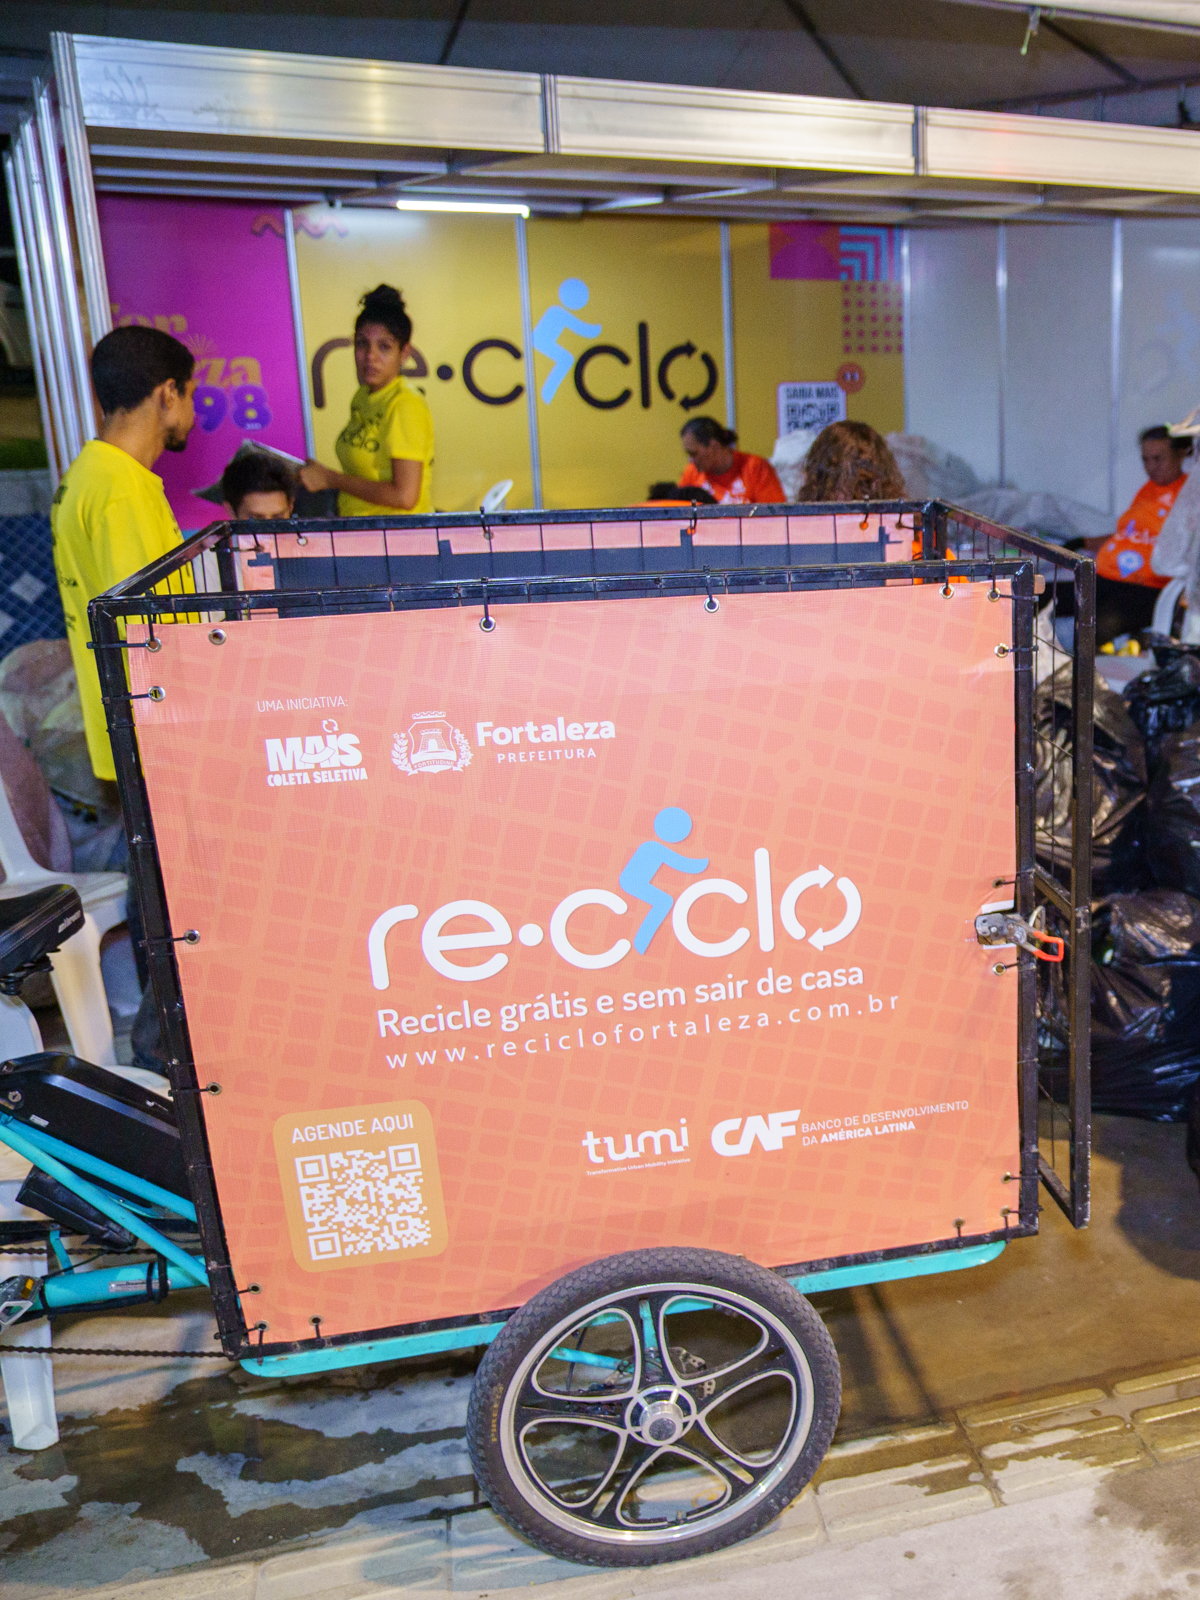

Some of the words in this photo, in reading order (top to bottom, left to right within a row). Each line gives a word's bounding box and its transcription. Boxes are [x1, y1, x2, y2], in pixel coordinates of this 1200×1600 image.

[257, 698, 285, 713] UMA
[286, 694, 349, 711] INICIATIVA:
[476, 716, 617, 747] Fortaleza
[265, 732, 364, 772] MAIS
[413, 759, 455, 770] FORTITUDINE
[496, 747, 597, 764] PREFEITURA
[267, 771, 311, 788] COLETA
[313, 767, 369, 784] SELETIVA
[378, 998, 492, 1038] Recicle
[499, 993, 589, 1032] grátis
[596, 994, 615, 1014] e
[621, 985, 687, 1012] sem
[694, 973, 749, 1004] sair
[756, 968, 793, 996] de
[799, 966, 864, 990] casa
[385, 993, 900, 1070] www.reciclofortaleza.com.br
[291, 1118, 367, 1144] AGENDE
[370, 1112, 415, 1134] AQUI
[801, 1117, 843, 1133] BANCO
[844, 1114, 861, 1129] DE
[861, 1100, 970, 1126] DESENVOLVIMENTO
[581, 1117, 690, 1164] tumi
[711, 1109, 801, 1157] CAF
[802, 1135, 819, 1147] DA
[819, 1124, 874, 1145] AMÉRICA
[873, 1120, 917, 1138] LATINA
[586, 1166, 627, 1177] Transformative
[627, 1164, 645, 1172] Urban
[644, 1160, 667, 1170] Mobility
[667, 1157, 691, 1166] Initiative
